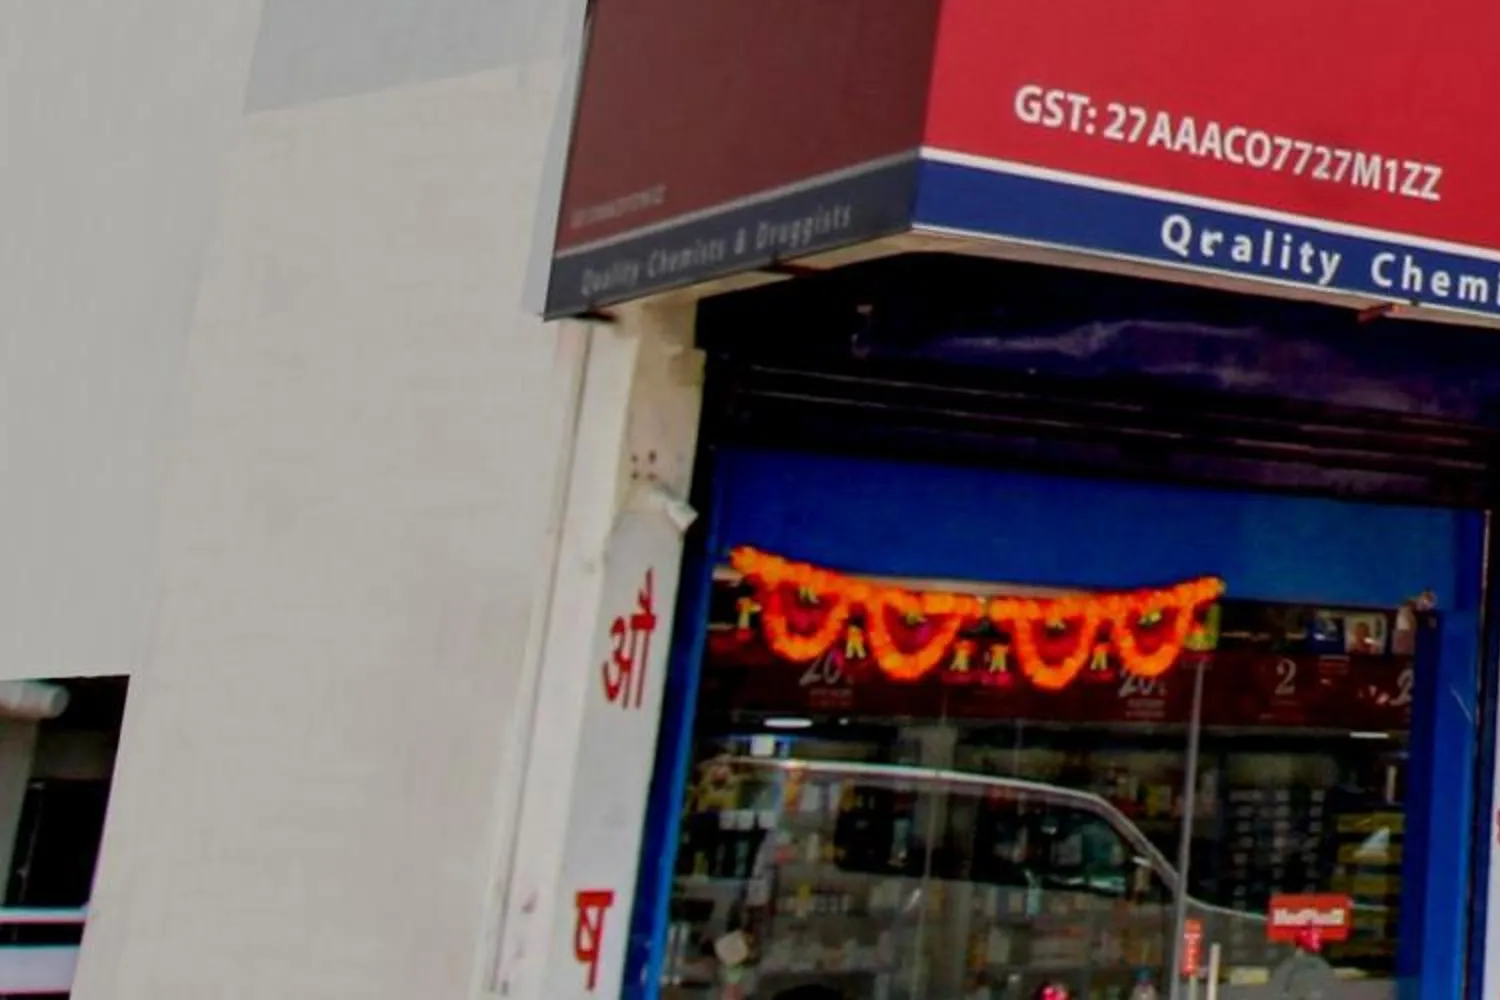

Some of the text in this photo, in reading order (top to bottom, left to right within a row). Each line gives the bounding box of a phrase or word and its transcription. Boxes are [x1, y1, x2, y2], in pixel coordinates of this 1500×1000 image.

[1014, 84, 1097, 135] GST:
[648, 239, 726, 278] Chemists
[756, 203, 851, 251] Druggists
